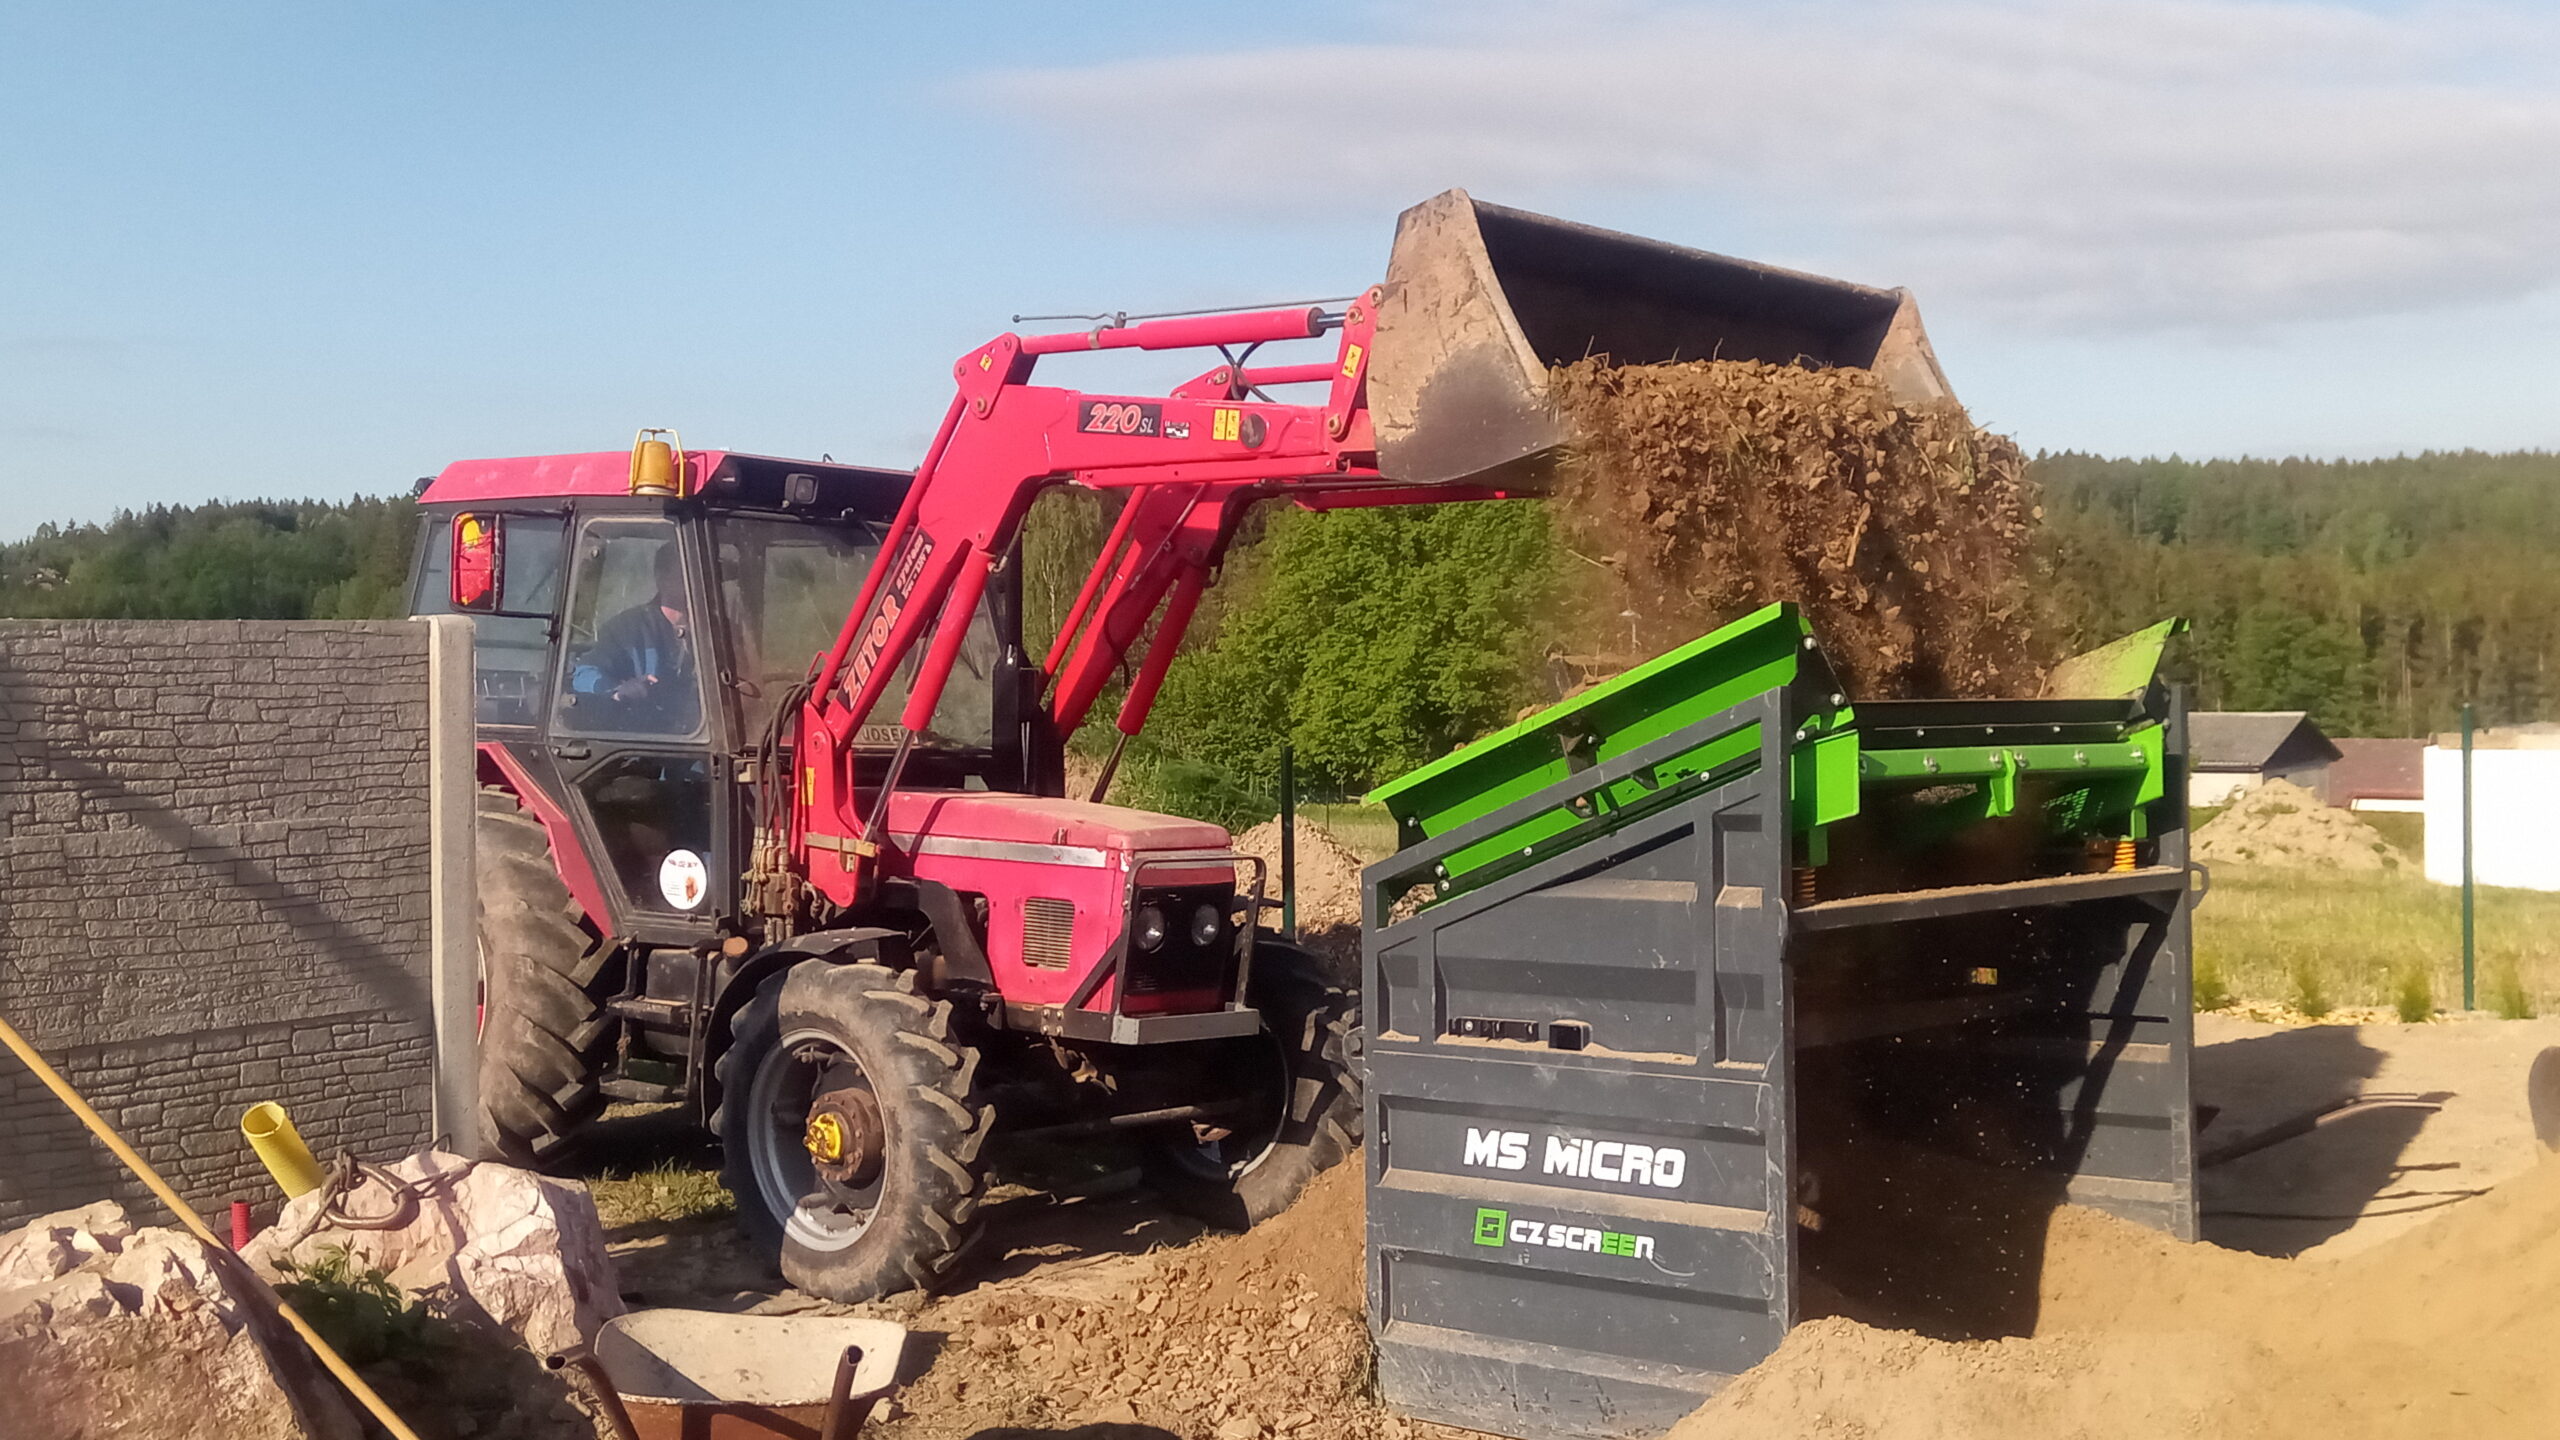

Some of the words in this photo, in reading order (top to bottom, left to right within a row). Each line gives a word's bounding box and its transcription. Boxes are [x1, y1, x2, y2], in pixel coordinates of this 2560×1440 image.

[1084, 403, 1141, 433] 220
[1140, 417, 1154, 433] SL
[843, 594, 901, 710] ZETOR
[1463, 1127, 1530, 1171] MS
[1542, 1135, 1687, 1189] MICRO
